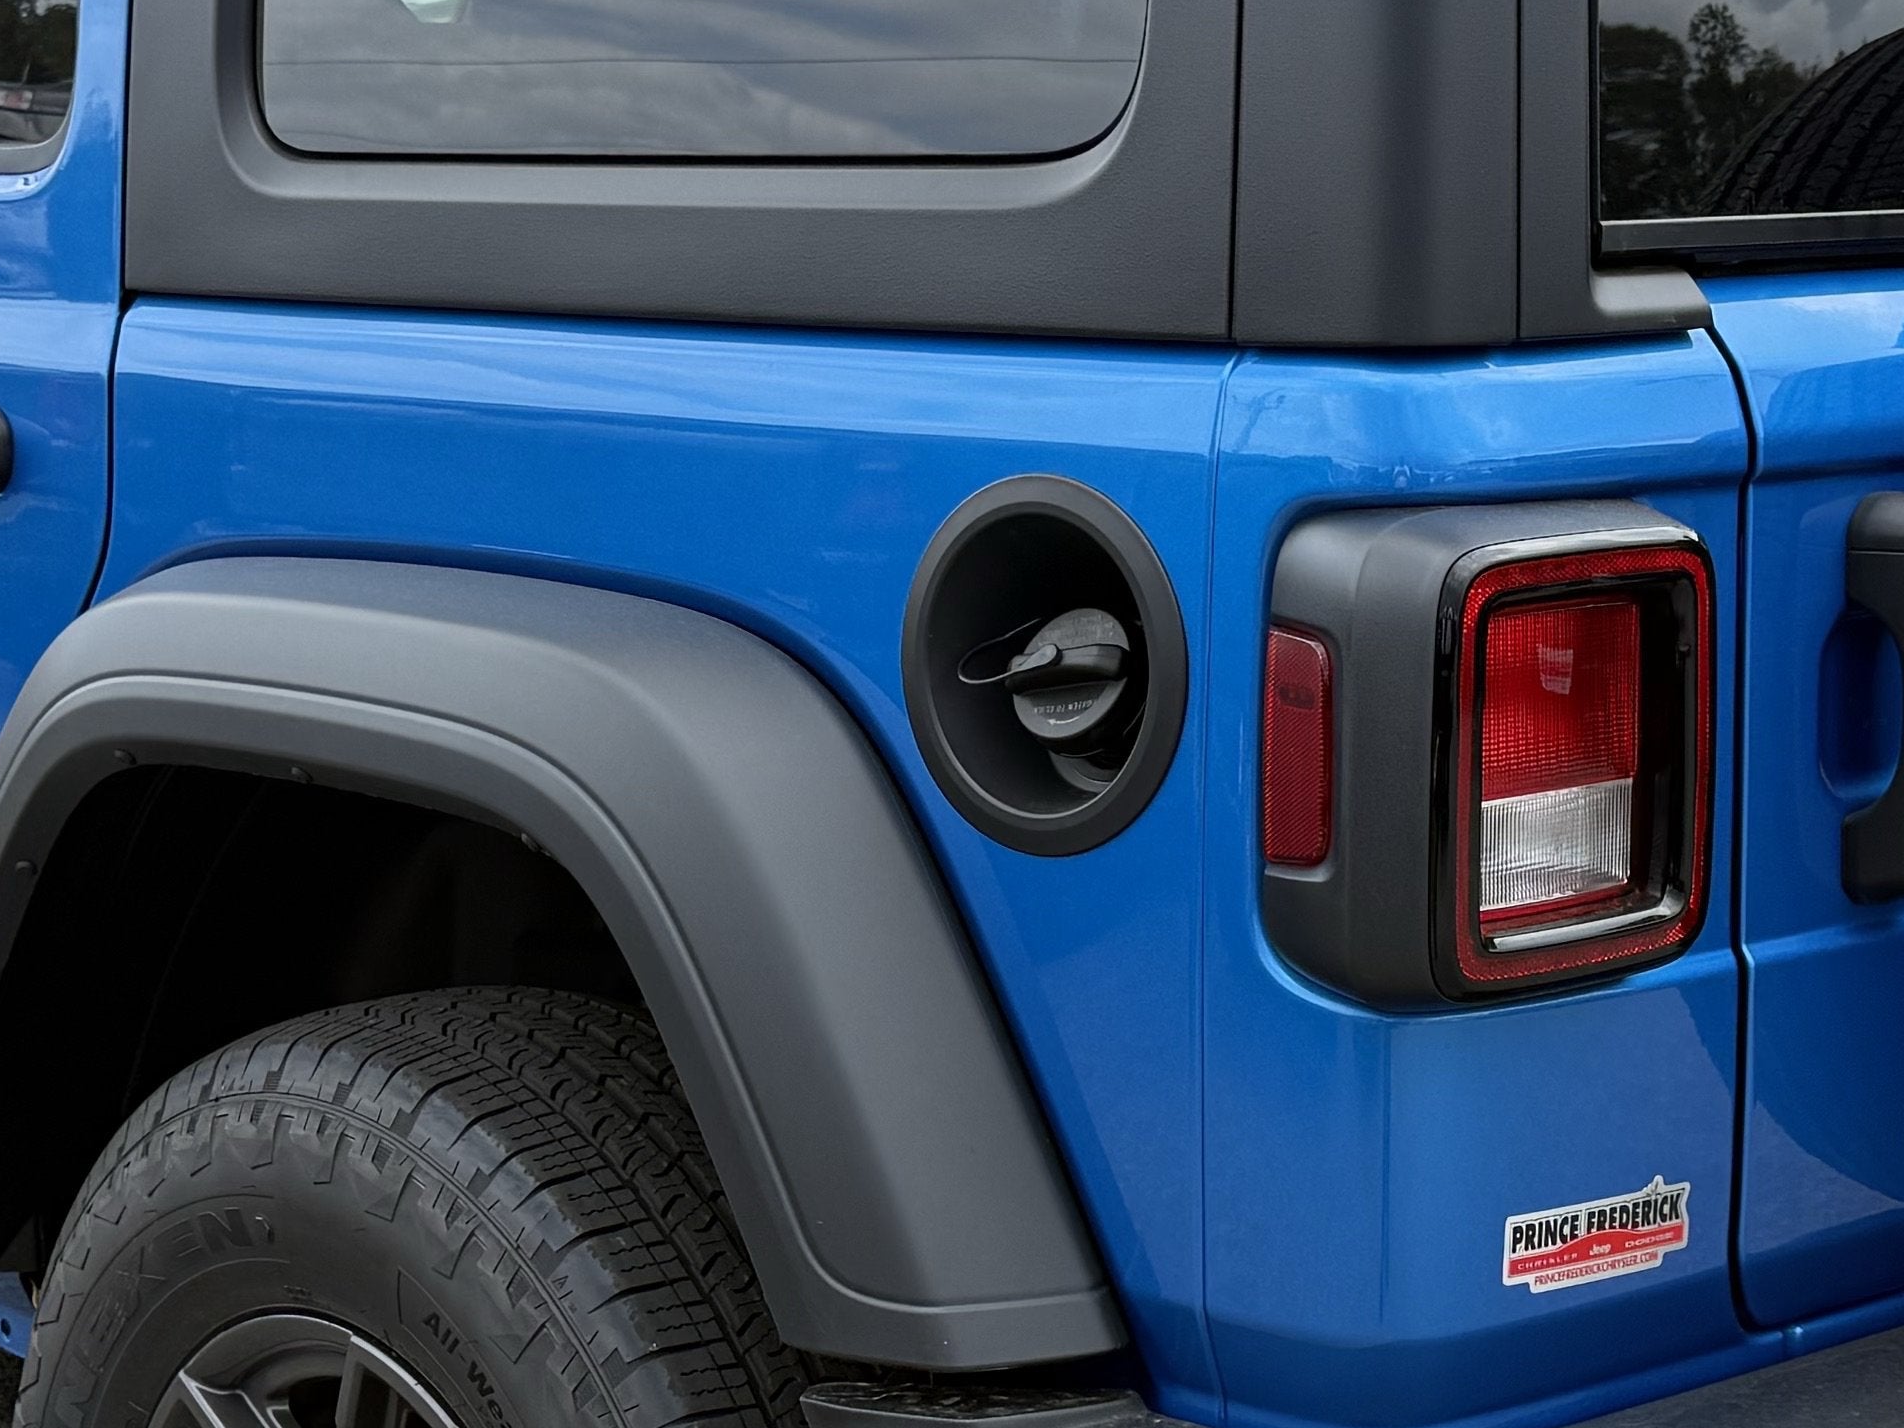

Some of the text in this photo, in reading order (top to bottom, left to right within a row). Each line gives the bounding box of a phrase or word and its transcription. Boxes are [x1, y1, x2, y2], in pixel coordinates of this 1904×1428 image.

[1511, 1192, 1682, 1254] PRINCE FREDERICK
[1588, 1242, 1612, 1257] Jeep
